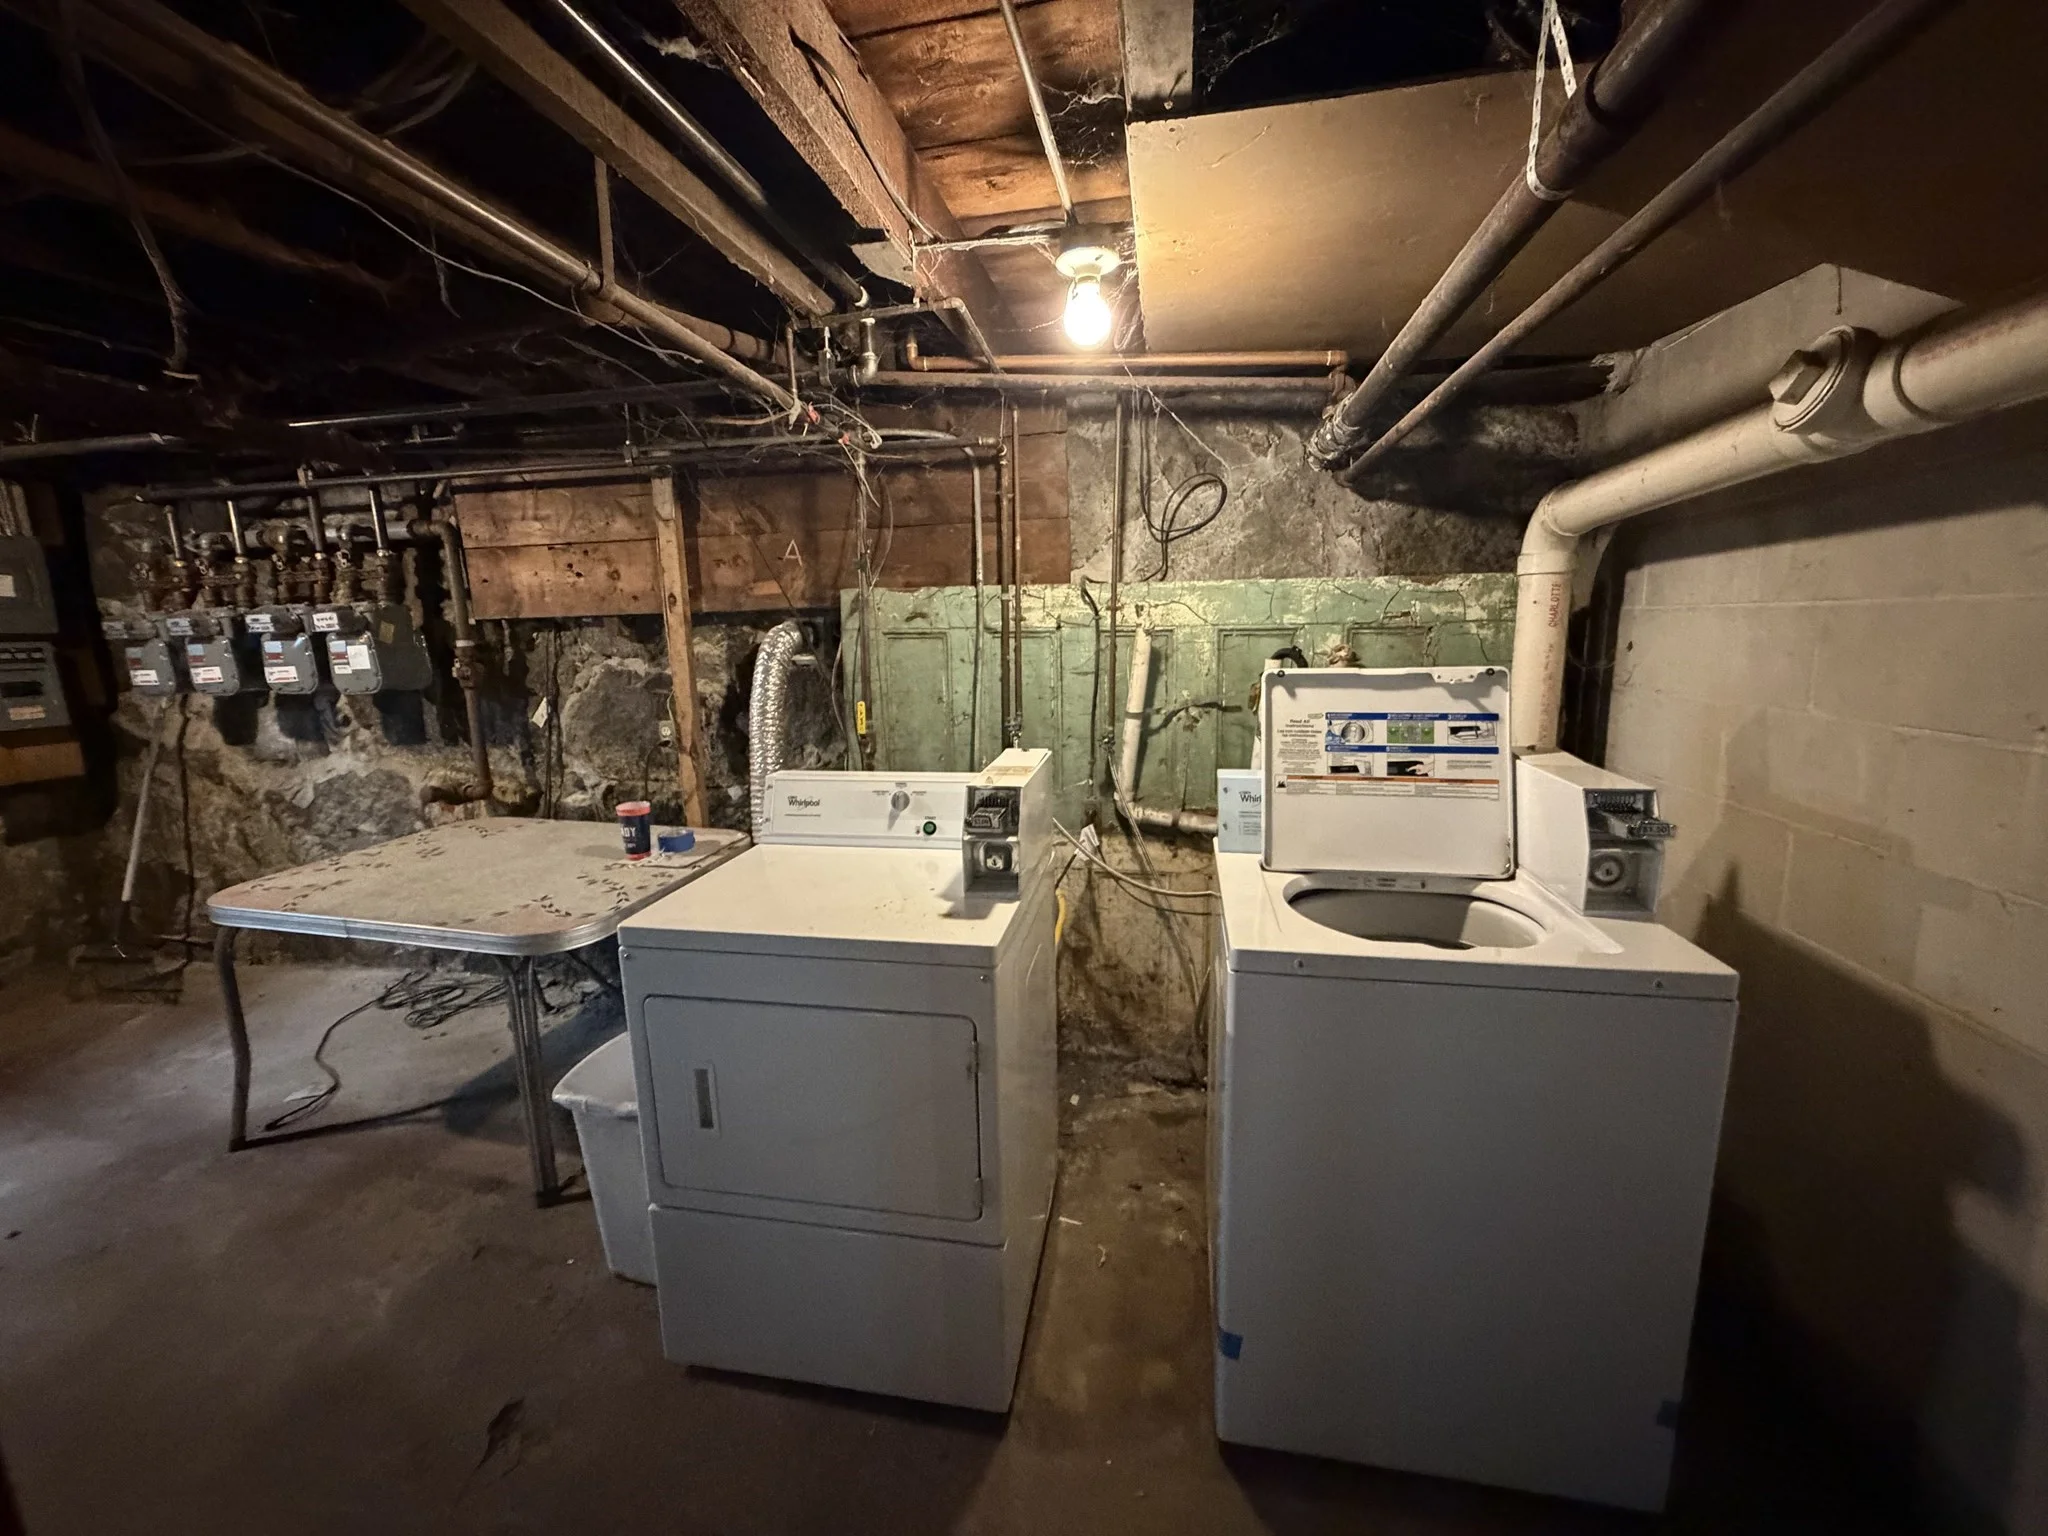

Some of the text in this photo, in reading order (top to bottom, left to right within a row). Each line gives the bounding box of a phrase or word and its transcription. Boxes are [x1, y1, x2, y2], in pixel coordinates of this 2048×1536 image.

[783, 539, 803, 567] A
[1548, 583, 1562, 627] CHARLOTTE
[788, 799, 821, 809] Whirlpool
[1240, 794, 1262, 803] Whirl
